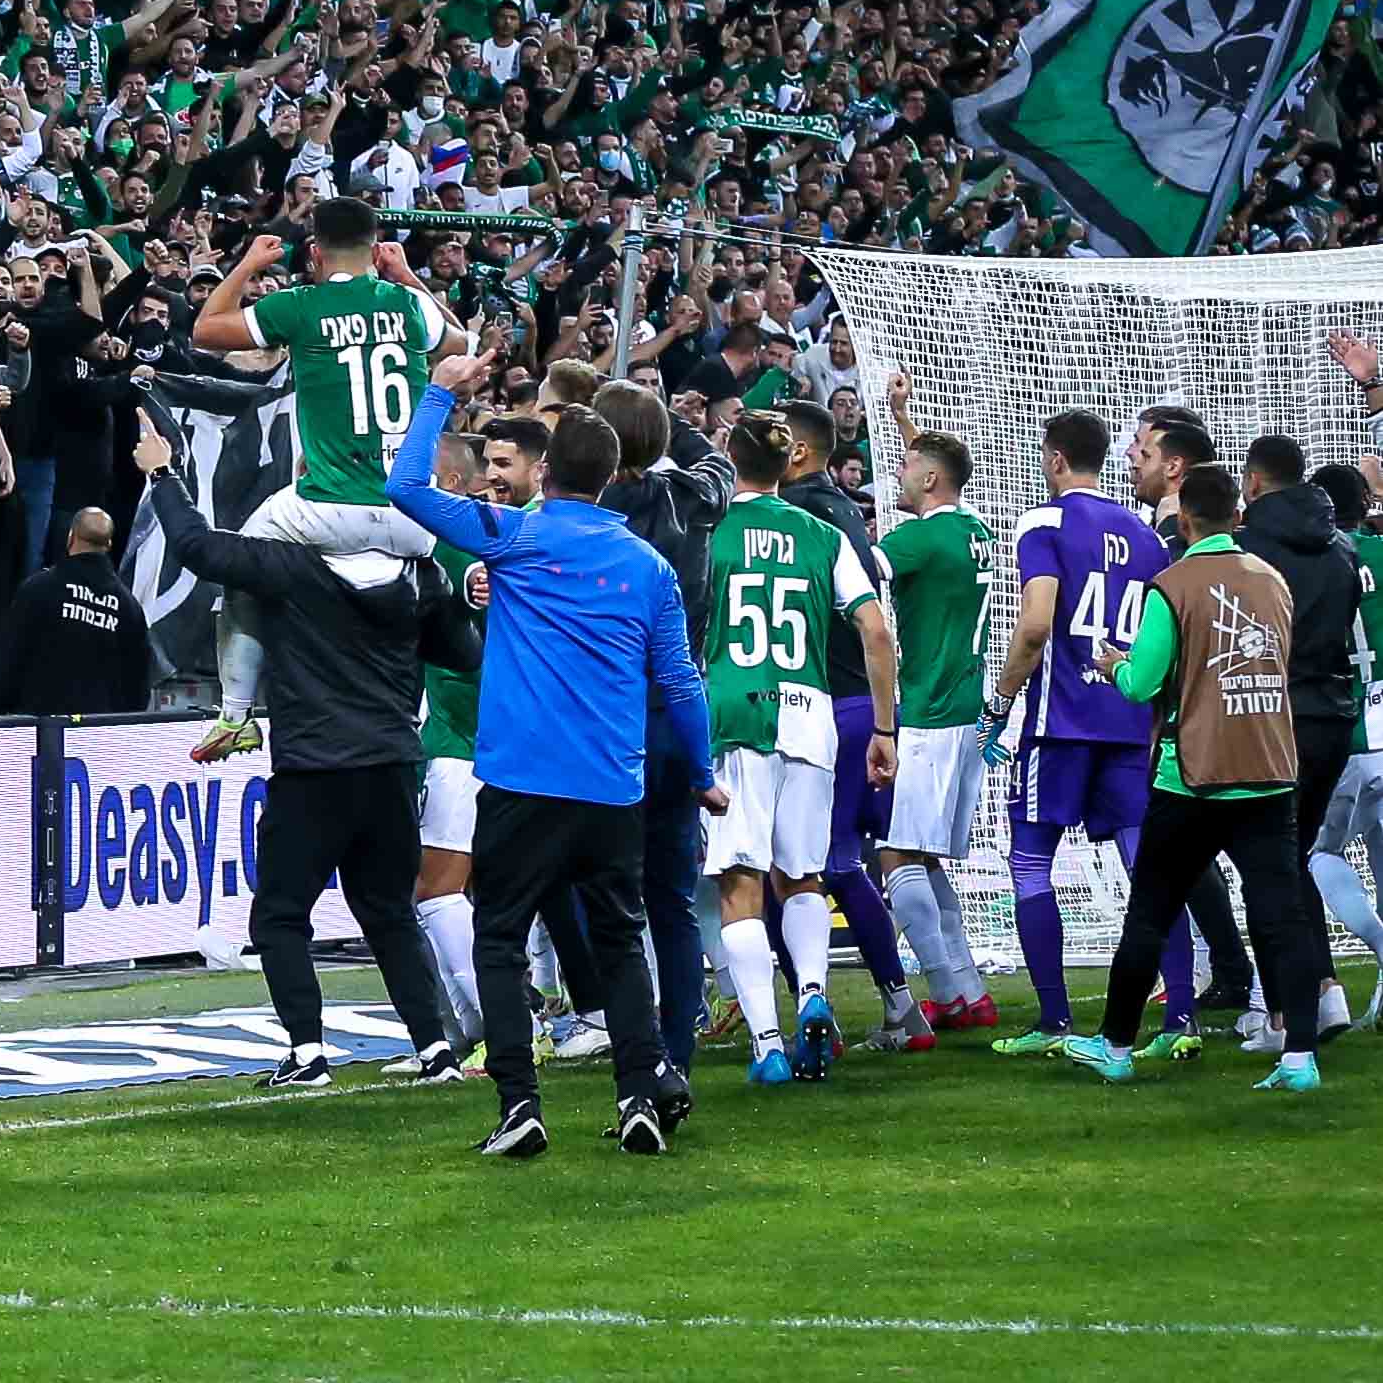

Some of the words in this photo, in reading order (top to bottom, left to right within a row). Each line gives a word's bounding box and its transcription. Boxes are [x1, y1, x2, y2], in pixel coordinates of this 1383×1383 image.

[320, 314, 368, 347] פאני
[372, 311, 407, 343] אבו
[337, 342, 412, 435] 16
[743, 528, 794, 569] גרשון
[1103, 532, 1130, 572] כהן
[62, 602, 119, 632] אבטחה
[728, 573, 810, 671] 55
[1069, 571, 1145, 661] 44
[759, 689, 812, 712] variety
